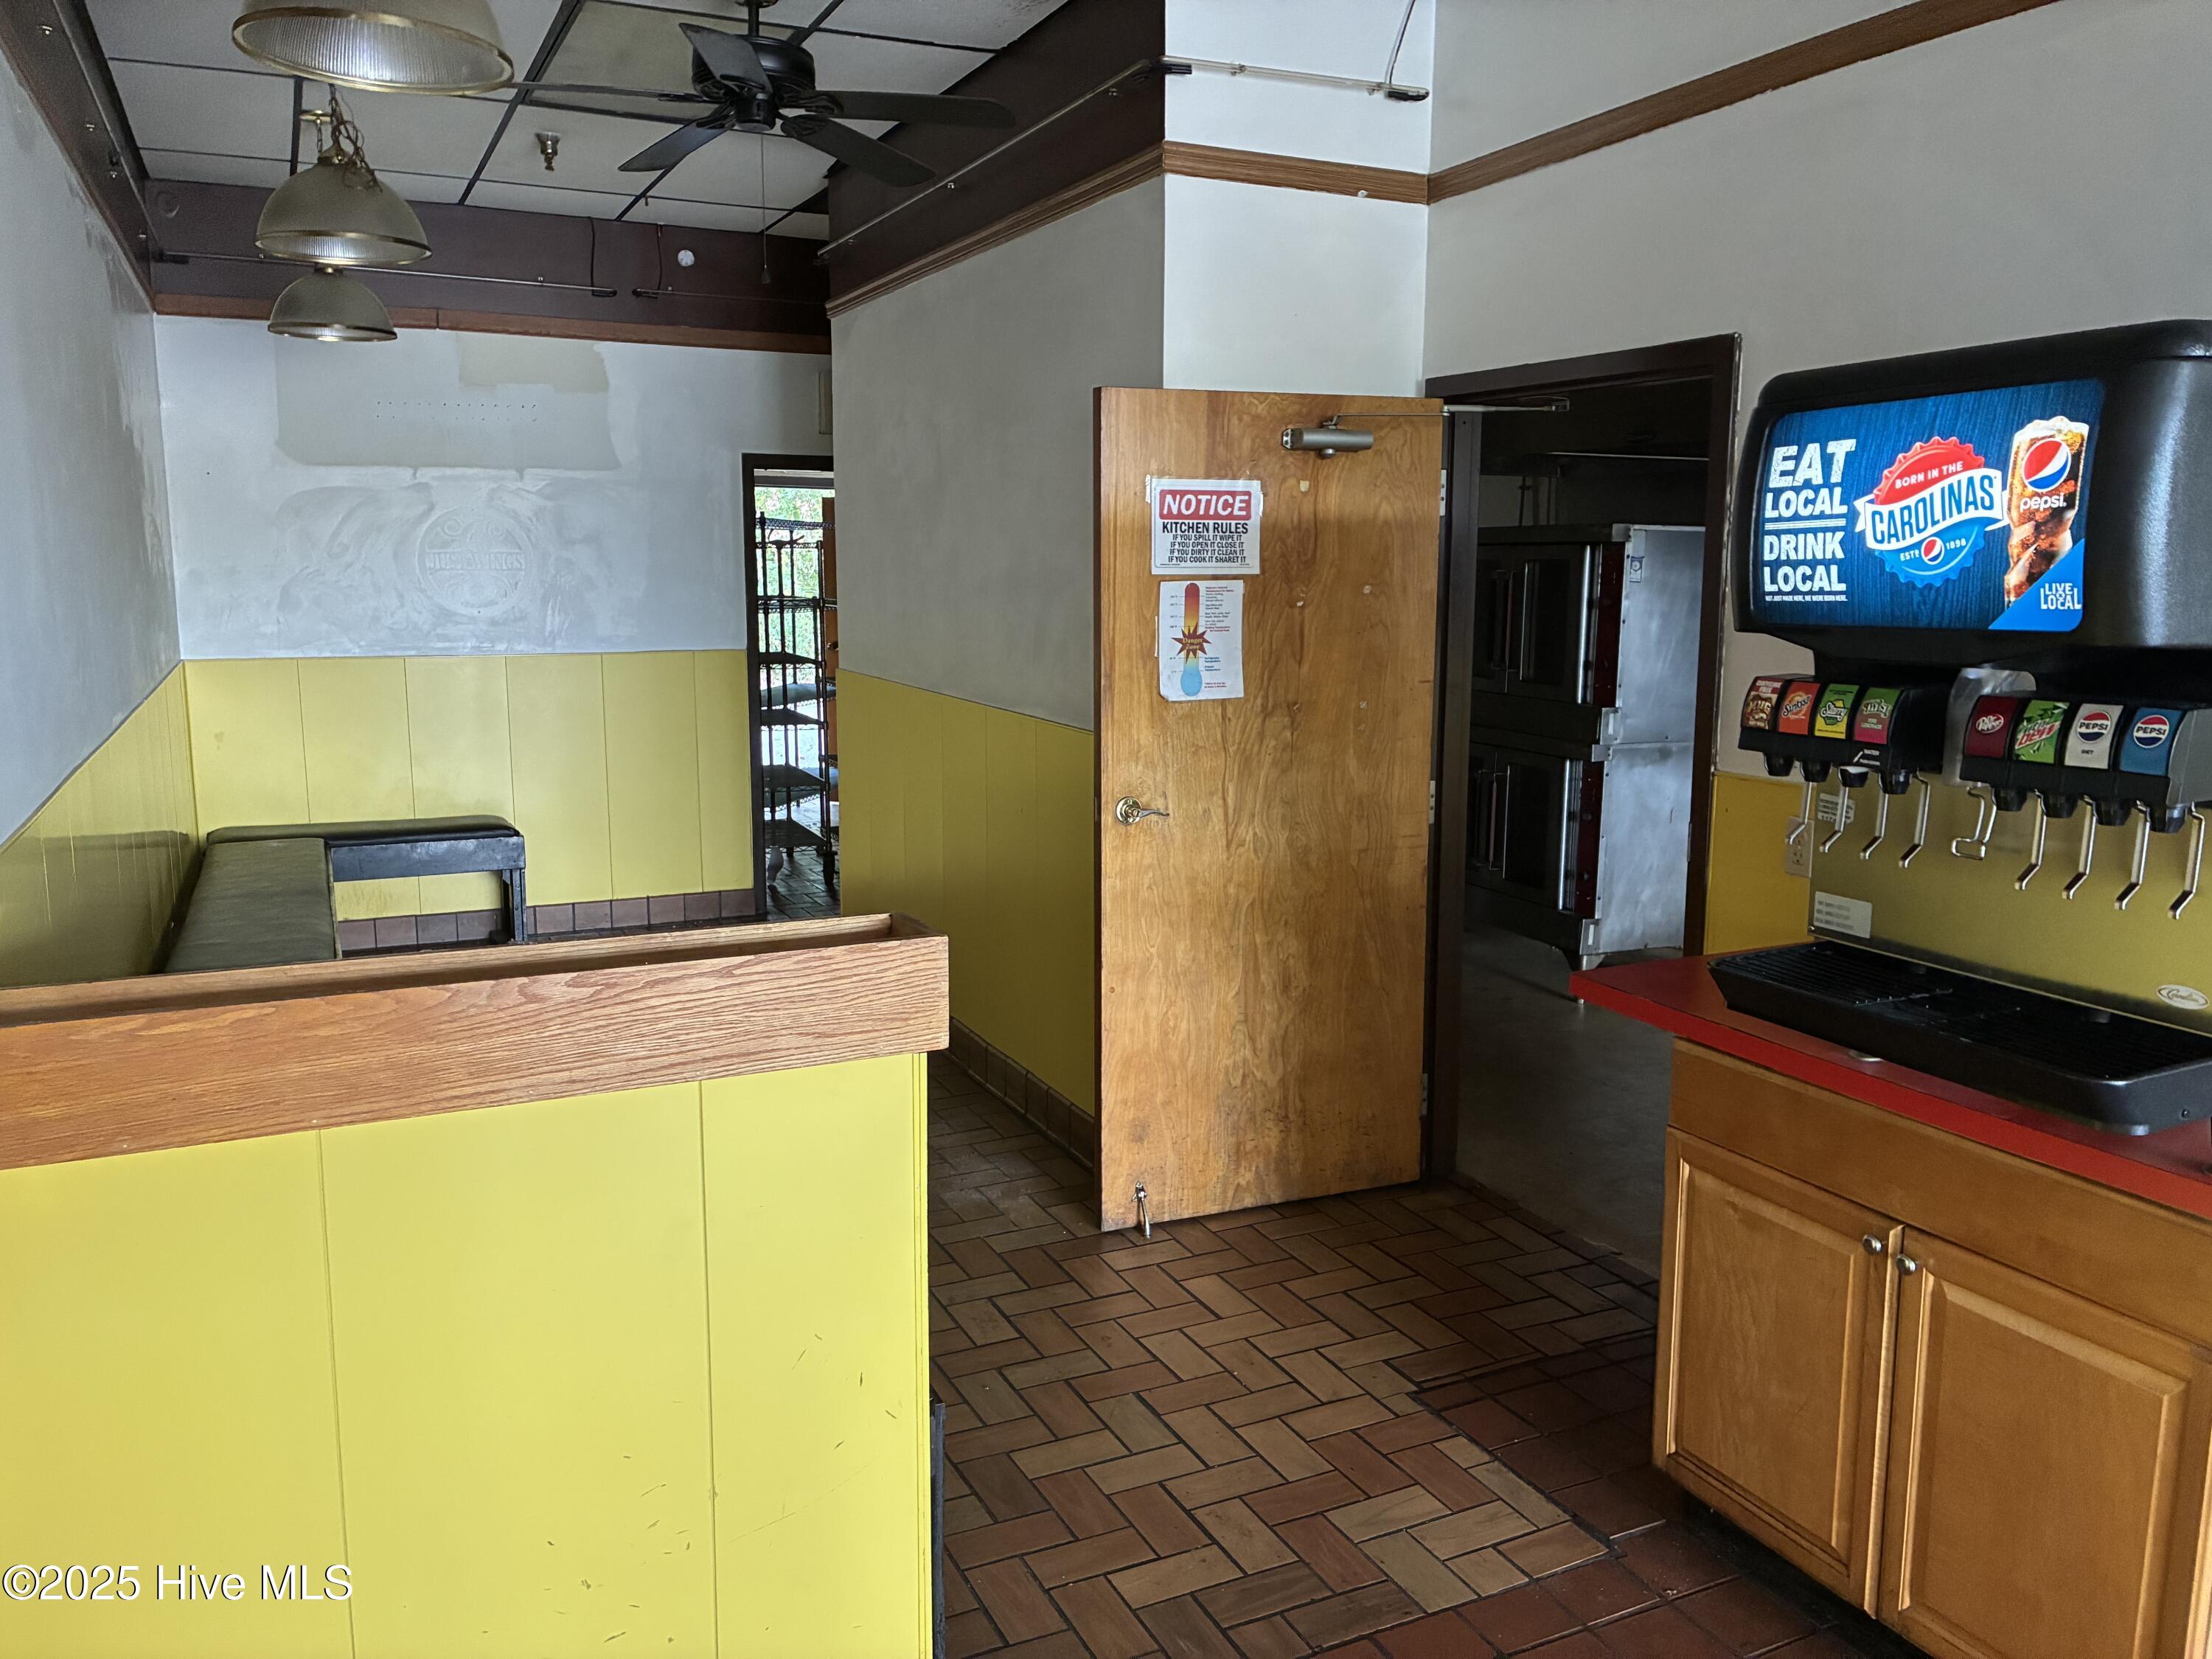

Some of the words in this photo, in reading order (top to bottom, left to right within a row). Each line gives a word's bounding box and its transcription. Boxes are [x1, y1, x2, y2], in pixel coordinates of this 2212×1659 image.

[1769, 439, 1857, 488] EAT
[1894, 473, 1924, 489] BORN
[1927, 468, 1939, 479] IN
[1941, 461, 1964, 476] THE
[1163, 494, 1249, 515] NOTICE
[1764, 487, 1848, 518] LOCAL
[1871, 474, 1994, 544] CAROLINAS
[2020, 493, 2064, 512] pepsi
[1162, 521, 1209, 534] KITCHEN
[1213, 522, 1248, 535] RULES
[1763, 531, 1845, 560] DRINK
[1946, 538, 1966, 550] 1898
[1763, 564, 1846, 592] LOCAL
[2045, 582, 2073, 595] LIVE
[2040, 588, 2081, 610] LOCAL
[2079, 722, 2108, 731] PEPSI
[2135, 726, 2166, 735] PEPSI
